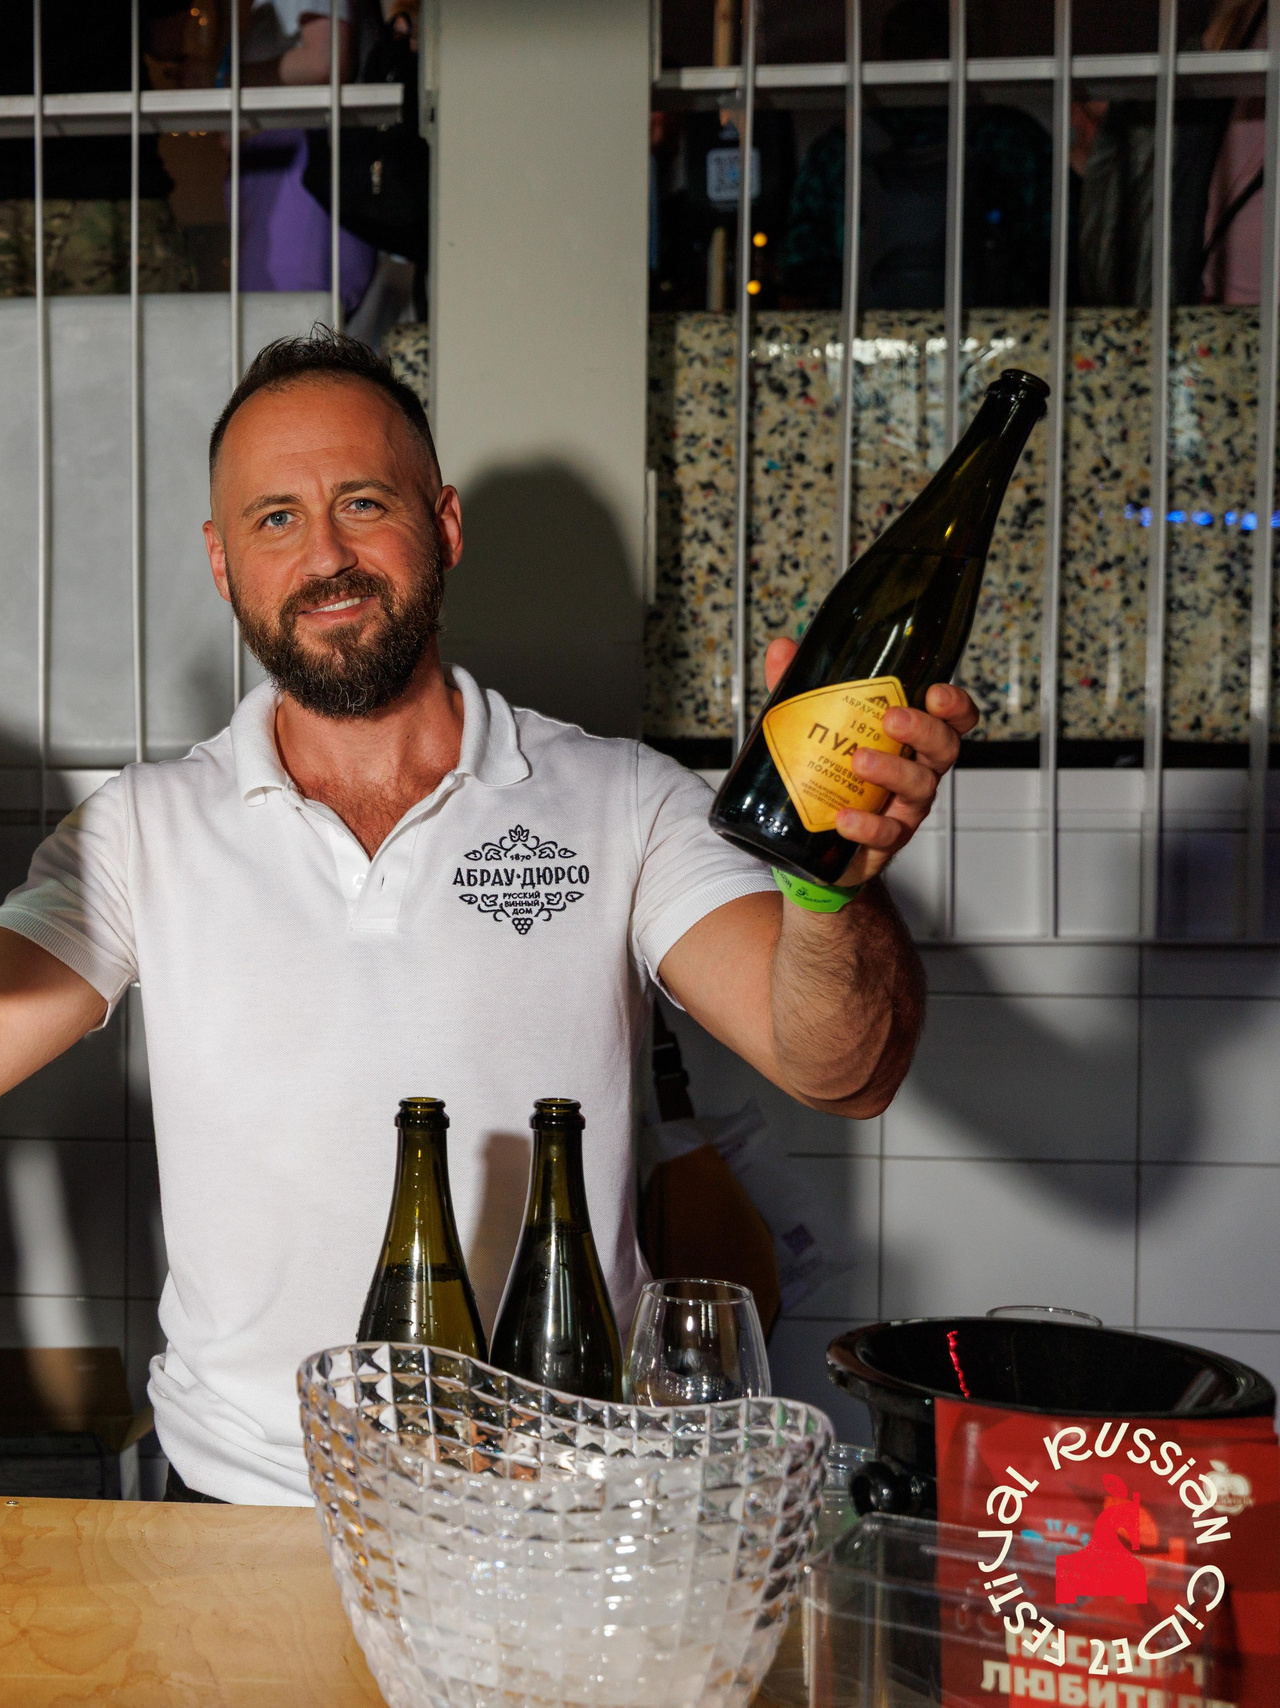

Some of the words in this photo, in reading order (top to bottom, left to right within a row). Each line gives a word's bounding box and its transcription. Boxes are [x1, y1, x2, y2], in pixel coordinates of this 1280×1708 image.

[850, 719, 881, 742] 1870
[807, 722, 860, 758] ПУА
[806, 760, 865, 797] ПОЛУСУХОЙ
[509, 853, 532, 862] 1870
[502, 890, 541, 899] РУССКИЙ
[504, 899, 541, 908] ВИННЫЙ
[511, 907, 533, 916] ДОМ
